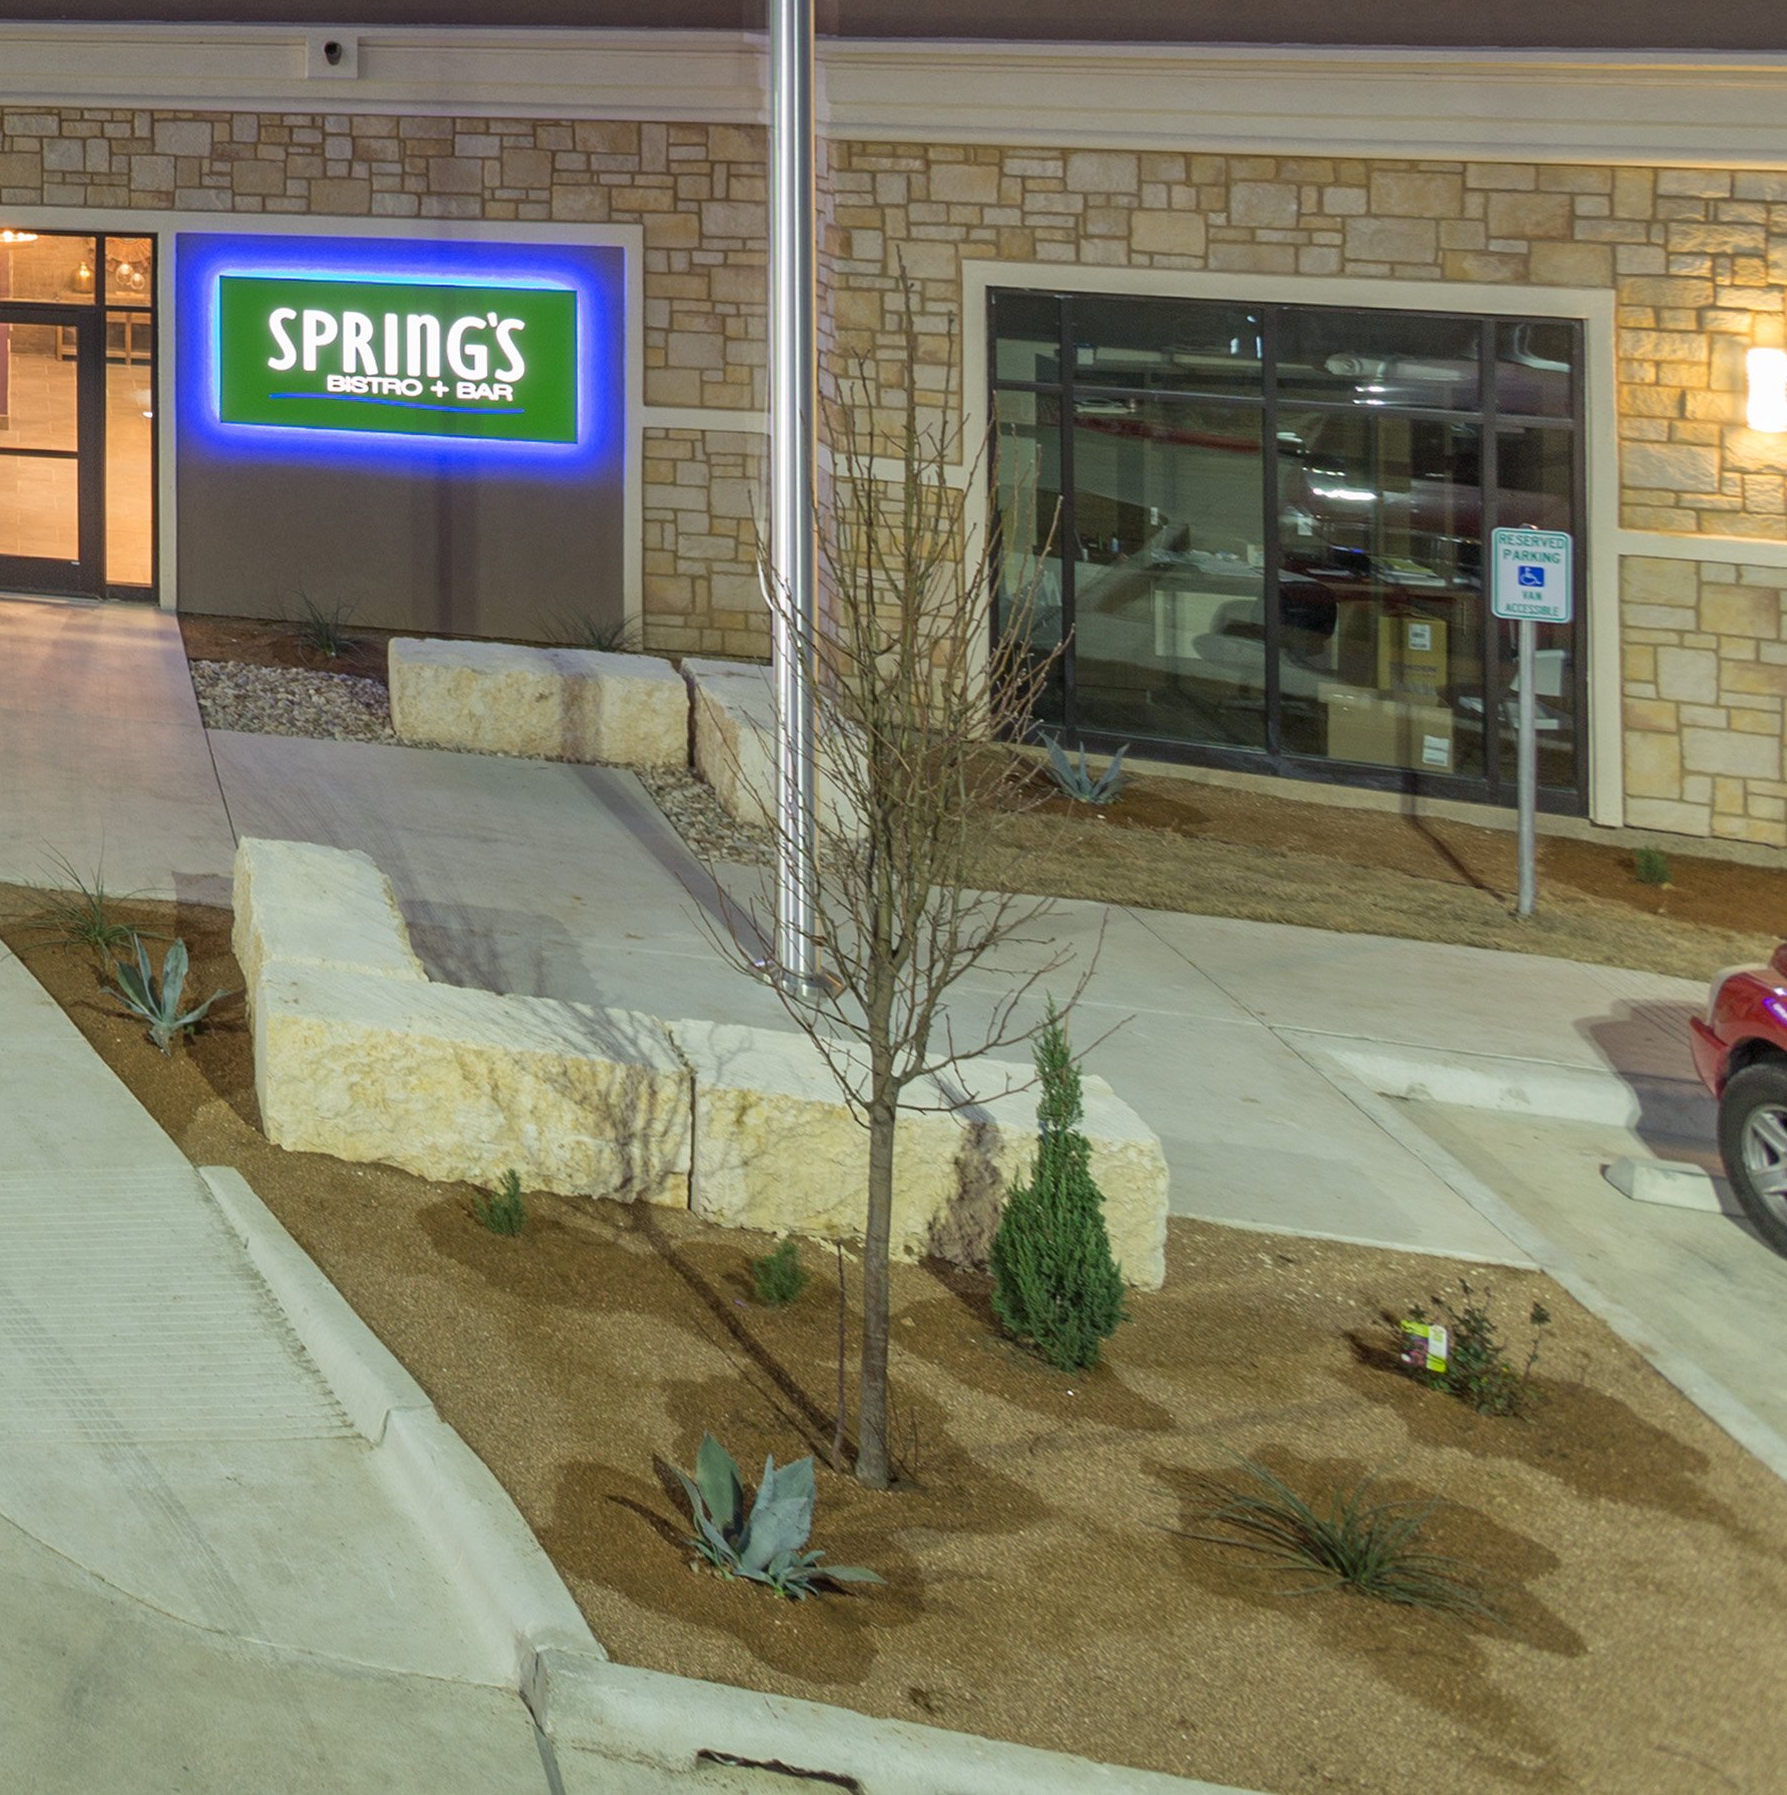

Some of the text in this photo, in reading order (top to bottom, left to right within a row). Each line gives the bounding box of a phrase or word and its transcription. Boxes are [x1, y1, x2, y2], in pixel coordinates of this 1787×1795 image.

[327, 374, 424, 397] BISTRO
[456, 381, 514, 402] BAR
[1499, 533, 1565, 550] RESERVED
[1503, 549, 1561, 565] PARKING
[1522, 591, 1543, 601] VAN
[1504, 603, 1560, 617] ACCESSIBLE
